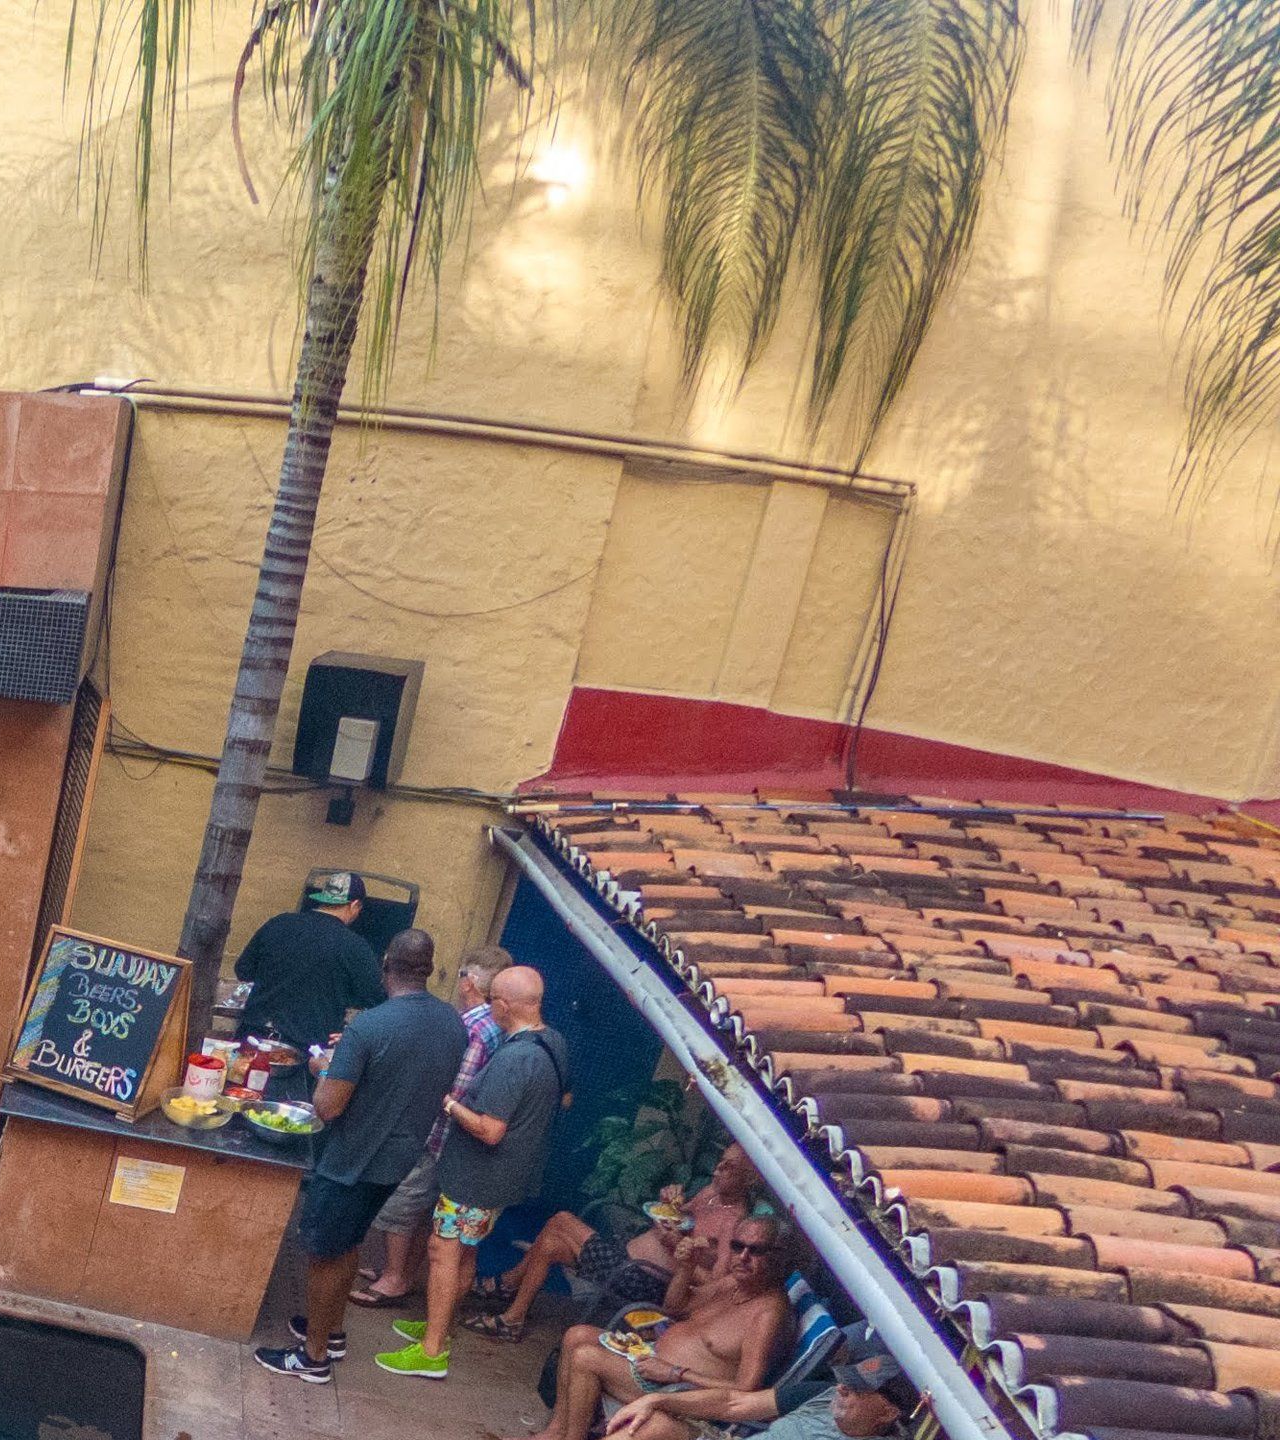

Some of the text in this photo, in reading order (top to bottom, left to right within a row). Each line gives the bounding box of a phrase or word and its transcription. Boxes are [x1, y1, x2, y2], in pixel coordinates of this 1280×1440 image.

[70, 945, 178, 996] SUNDAY
[68, 972, 143, 1014] BEERS,
[66, 998, 136, 1040] BOYS
[72, 1028, 93, 1057] &
[31, 1039, 138, 1101] BURGERS
